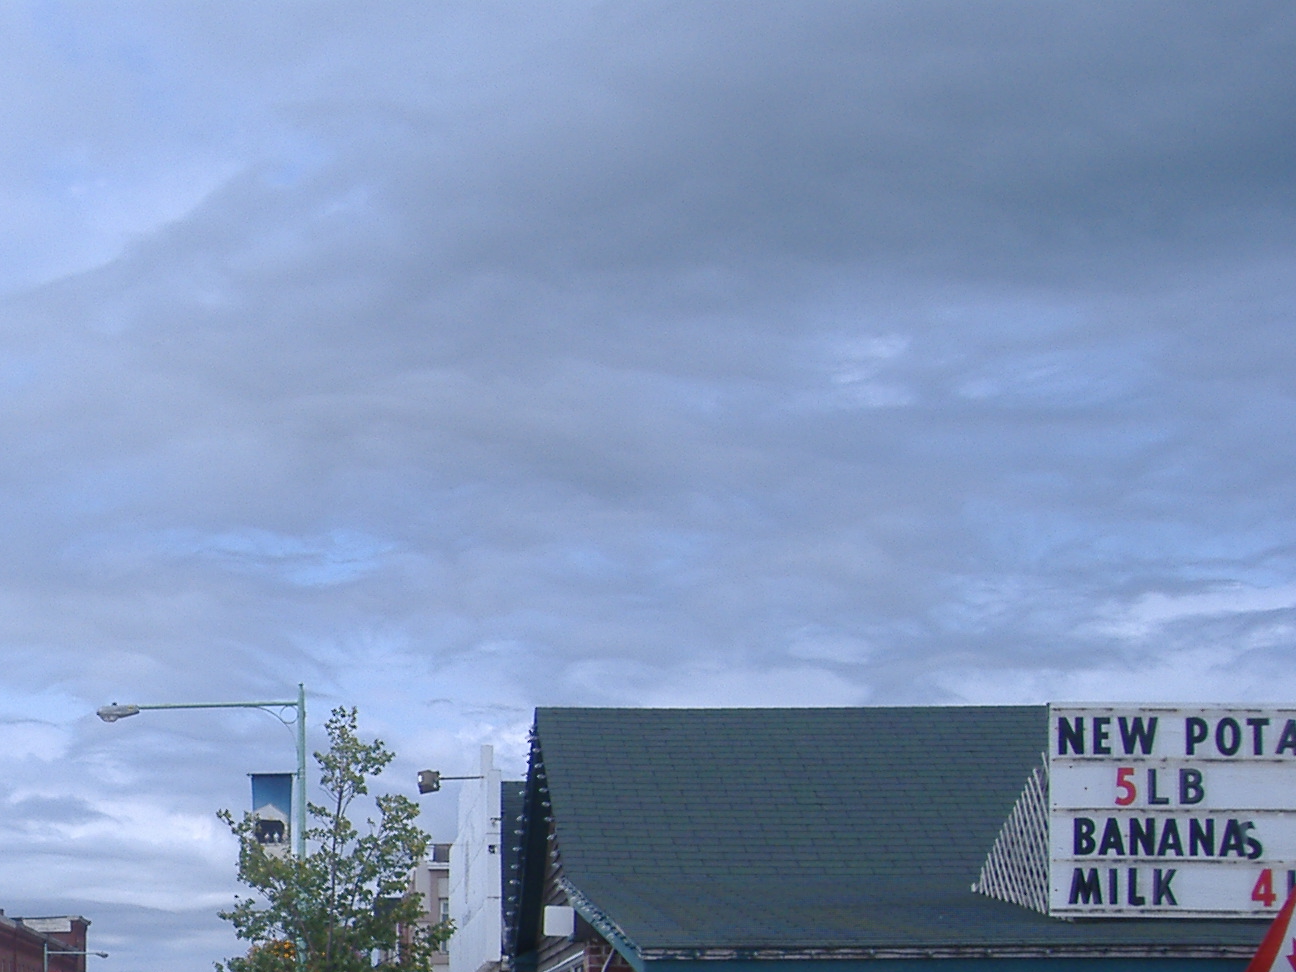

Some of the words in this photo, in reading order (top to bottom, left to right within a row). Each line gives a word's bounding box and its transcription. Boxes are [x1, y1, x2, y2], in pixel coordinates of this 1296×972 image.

[1058, 716, 1159, 755] NEW
[1185, 716, 1296, 756] POTA
[1073, 817, 1264, 860] BANANAS
[1068, 867, 1178, 906] MILK
